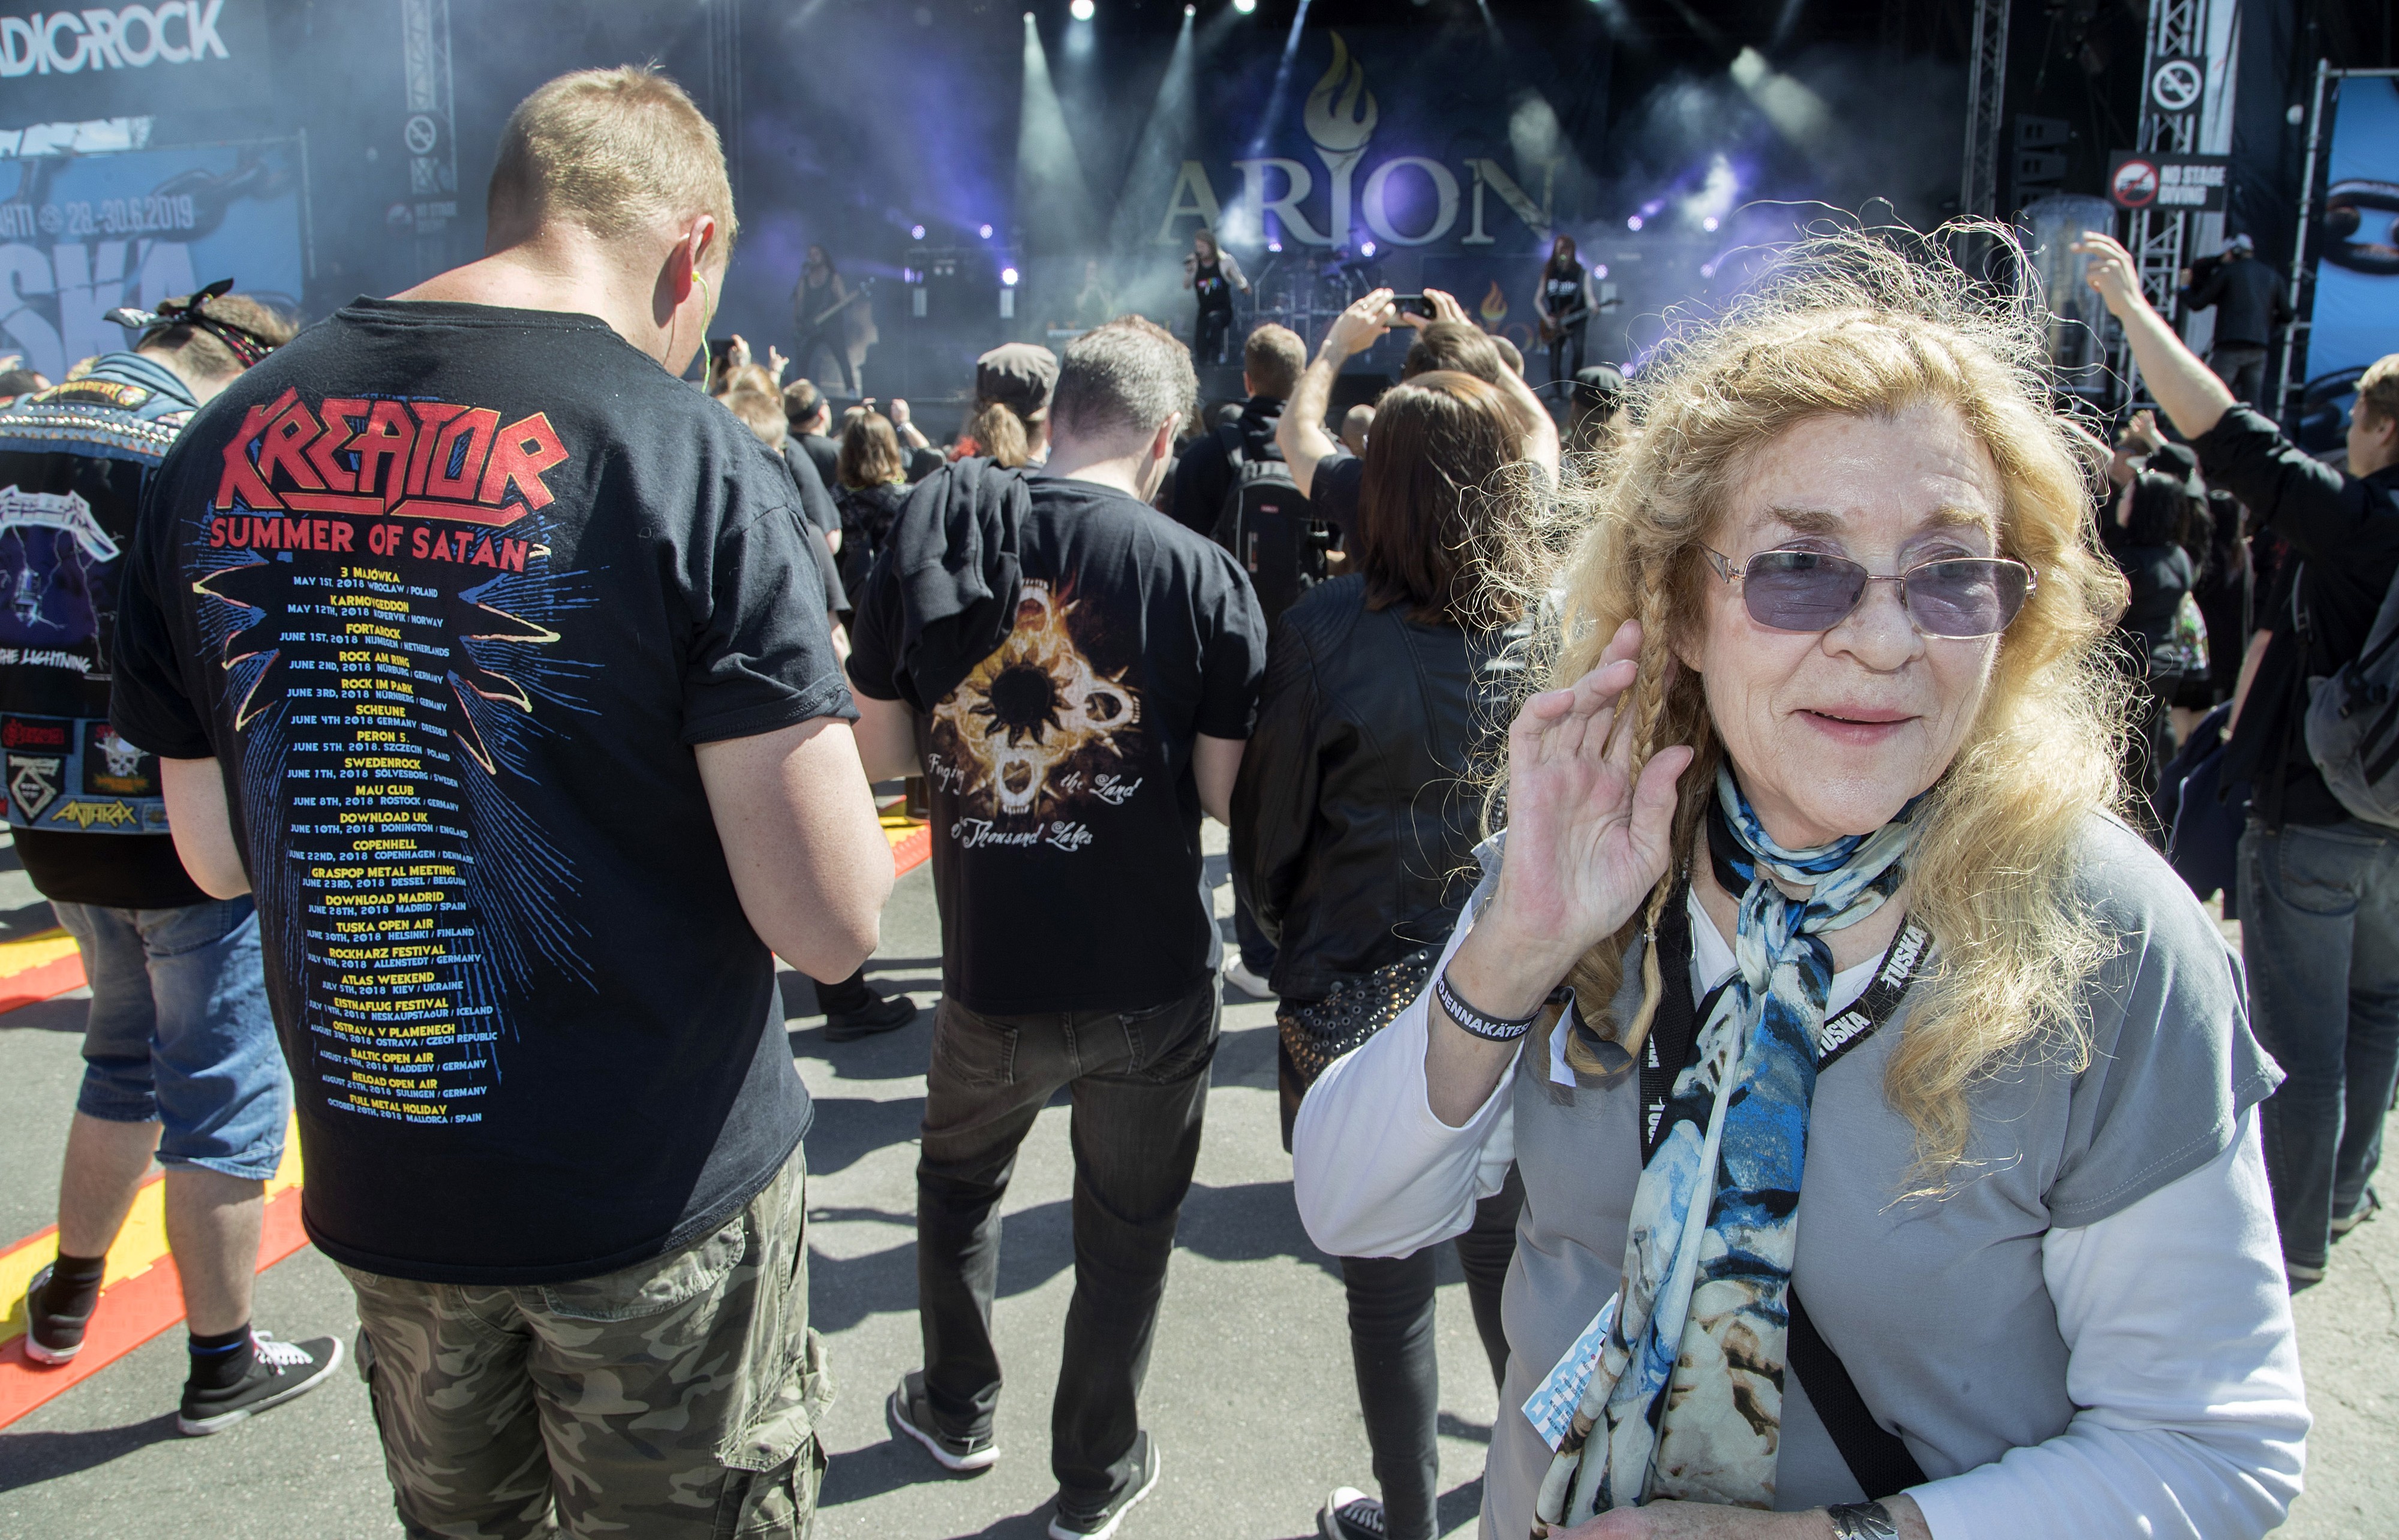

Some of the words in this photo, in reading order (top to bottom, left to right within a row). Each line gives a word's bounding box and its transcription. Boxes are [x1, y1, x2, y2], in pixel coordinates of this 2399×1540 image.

[0, 0, 230, 77] DIOROCK
[2160, 164, 2181, 184] NO
[2183, 165, 2226, 187] STAGE
[1156, 148, 1565, 247] ARION
[2158, 184, 2208, 205] DIVING
[216, 386, 569, 526] KREATOR
[209, 518, 354, 552] SUMMER
[368, 523, 405, 557] OF
[412, 527, 529, 573] SATAN
[341, 567, 348, 578] 3
[293, 576, 315, 585] MAY
[336, 579, 364, 588] 2018
[410, 586, 438, 597] POLAND
[288, 604, 311, 613] MAY
[341, 607, 369, 616] 2018
[411, 615, 443, 627] NORWAY
[345, 623, 401, 639] FORTAROCK
[279, 632, 305, 640] JUNE
[330, 634, 357, 643] 2018
[404, 641, 449, 657] NETHERLANDS
[339, 651, 370, 661] ROCK
[374, 652, 389, 663] AM
[390, 654, 410, 667] RING
[289, 660, 315, 669] JUNE
[342, 663, 371, 671] 2018
[414, 670, 443, 684] GERMANY
[341, 678, 372, 688] ROCK
[375, 679, 389, 690] IM
[390, 680, 413, 694] PARK
[287, 688, 312, 697] JUNE
[341, 690, 369, 698] 2018
[419, 697, 447, 711] GERMANY
[356, 704, 405, 717] SCHEUNE
[291, 715, 317, 724] JUNE
[344, 715, 373, 724] 2018
[377, 716, 416, 728] GERMANY
[421, 722, 447, 736] DRESDEN
[357, 730, 395, 742] PERON
[293, 742, 318, 751] JUNE
[383, 742, 422, 754] SZCZECIN
[426, 748, 450, 761] POLAND
[344, 757, 421, 769] SWEDENROCK
[287, 769, 310, 778] JUNE
[339, 769, 368, 778] 2018
[375, 768, 428, 780] SÖLVESBORG
[433, 773, 458, 787] SWEDEN
[356, 784, 383, 795] MAU
[387, 784, 414, 795] CLUB
[1089, 774, 1143, 805] Land
[293, 797, 315, 805] JUNE
[345, 796, 373, 805] 2018
[380, 796, 420, 805] ROSTOCK
[427, 798, 458, 811] GERMANY
[50, 799, 137, 829] ANTHRAX
[339, 811, 410, 823] DOWNLOAD
[413, 812, 427, 822] UK
[290, 823, 310, 833] JUNE
[346, 824, 374, 833] 2018
[381, 823, 433, 832] DONINGTON
[439, 825, 468, 838] ENGLAND
[963, 817, 1044, 849] Thousand
[1045, 820, 1093, 852] Lakes
[353, 838, 417, 850] COPENHELL
[289, 850, 305, 859] JUNE
[307, 852, 335, 862] 22ND,
[339, 852, 368, 861] 2018
[374, 850, 435, 859] COPENHAGEN
[442, 850, 474, 864] DENMARK
[311, 867, 364, 878] GRASPOP
[367, 866, 406, 877] METAL
[409, 865, 456, 876] MEETING
[302, 878, 321, 887] JUNE
[324, 879, 353, 889] 23RD,
[356, 878, 384, 888] 2018
[391, 877, 425, 886] DESSEL
[325, 893, 395, 906] DOWNLOAD
[398, 891, 444, 903] MADRID
[308, 904, 326, 914] JUNE
[329, 906, 357, 916] 28TH,
[360, 905, 389, 915] 2018
[396, 903, 432, 913] MADRID
[440, 902, 466, 910] SPAIN
[336, 922, 375, 933] TUSKA
[378, 919, 409, 931] OPEN
[413, 918, 434, 929] AIR
[388, 930, 428, 940] HELSINKI
[437, 928, 474, 937] FINLAND
[329, 948, 389, 959] ROCKHARZ
[392, 944, 445, 957] FESTIVAL
[1880, 925, 1928, 991] TUSKA
[374, 957, 429, 968] ALLENSTEDT
[436, 954, 481, 964] GERMANY
[341, 974, 374, 985] ATLAS
[377, 971, 434, 985] WEEKEND
[392, 984, 414, 994] KIEV
[423, 980, 463, 992] UKRAINE
[334, 997, 391, 1011] EISTNAFLUG
[395, 997, 448, 1011] FESTIVAL
[456, 1006, 493, 1016] ICELAND
[333, 1020, 375, 1036] OSTRAVA
[377, 1027, 386, 1036] V
[389, 1023, 455, 1037] PLAMENECH
[375, 1037, 418, 1046] OSTRAVA
[426, 1034, 454, 1045] CZECH
[456, 1031, 497, 1045] REPUBLIC
[351, 1048, 380, 1061] BALTIC
[381, 1053, 410, 1063] OPEN
[414, 1052, 434, 1063] AIR
[393, 1063, 434, 1072] HADDEBY
[442, 1059, 486, 1070] GERMANY
[352, 1071, 387, 1086] RELOAD
[388, 1078, 414, 1088] OPEN
[419, 1078, 437, 1088] AIR
[396, 1088, 435, 1098] SULINGEN
[442, 1085, 486, 1097] GERMANY
[349, 1094, 369, 1106] FULL
[371, 1098, 401, 1111] METAL
[402, 1103, 447, 1114] HOLIDAY
[406, 1114, 448, 1123] MALLORCA
[455, 1112, 482, 1123] SPAIN
